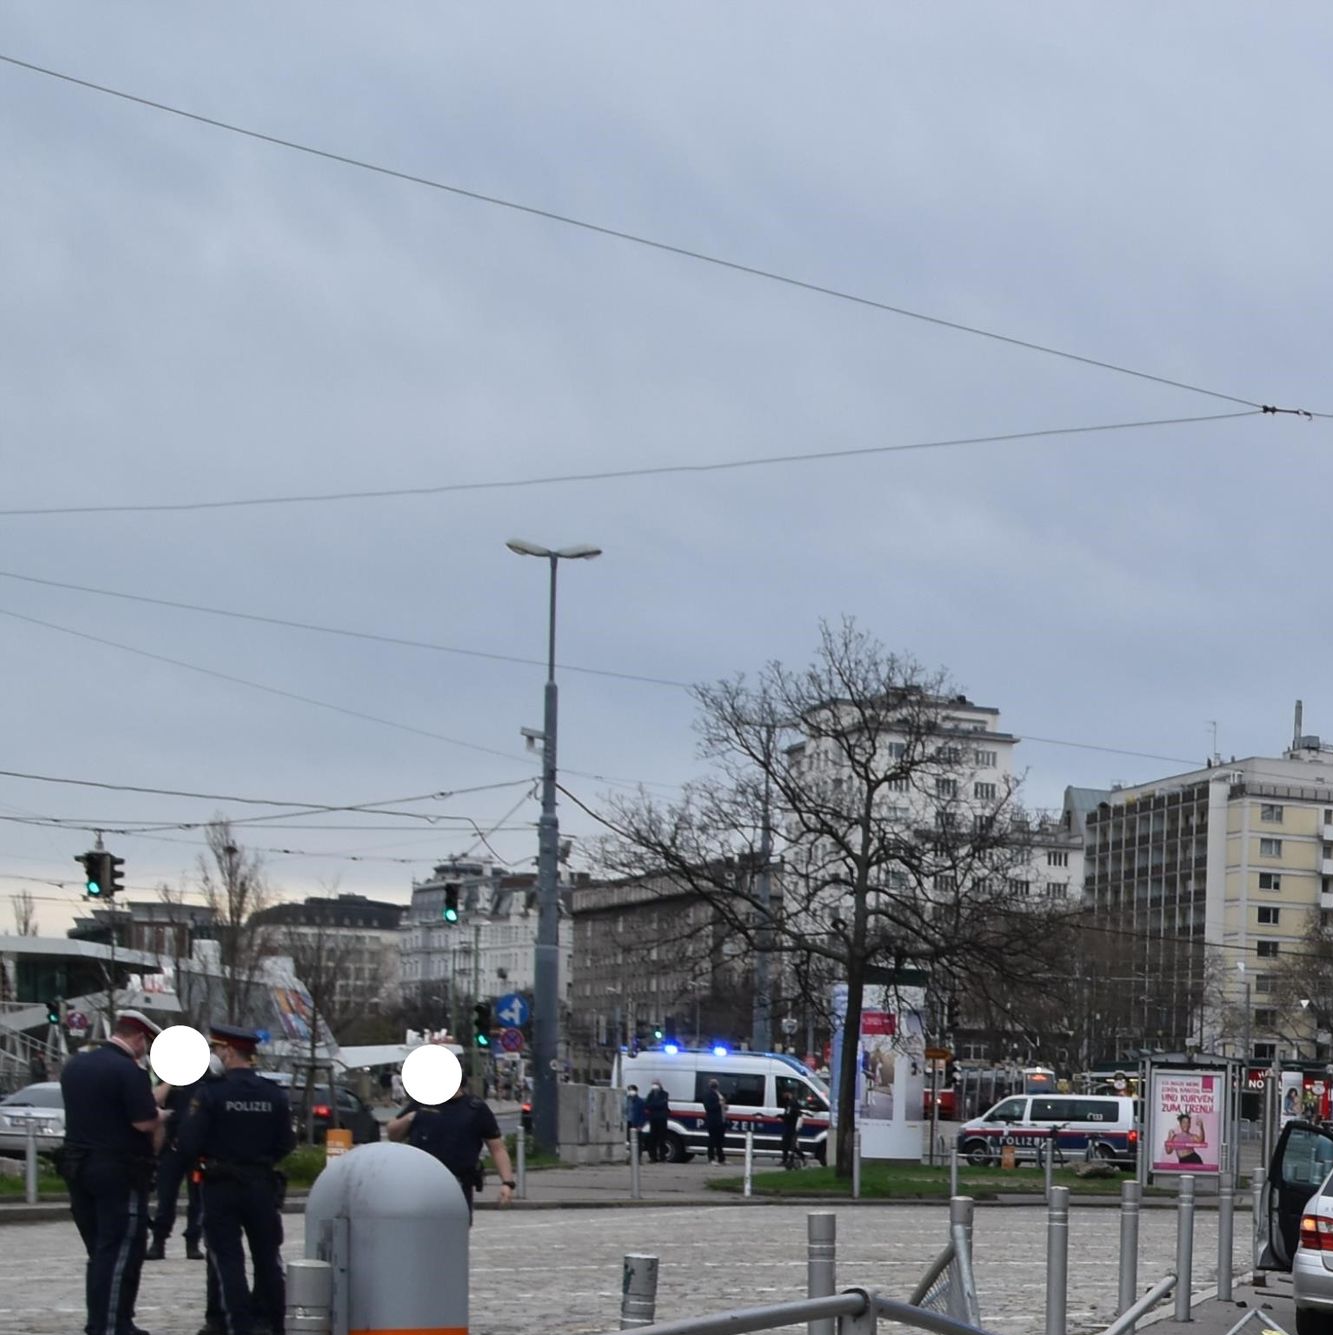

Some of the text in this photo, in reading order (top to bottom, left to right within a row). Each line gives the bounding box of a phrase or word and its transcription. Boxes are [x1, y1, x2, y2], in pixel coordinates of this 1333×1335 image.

[1180, 1094, 1214, 1103] KURVEN
[225, 1101, 273, 1112] POLIZEI
[1161, 1103, 1180, 1112] ZUM
[696, 1118, 754, 1131] PZEI
